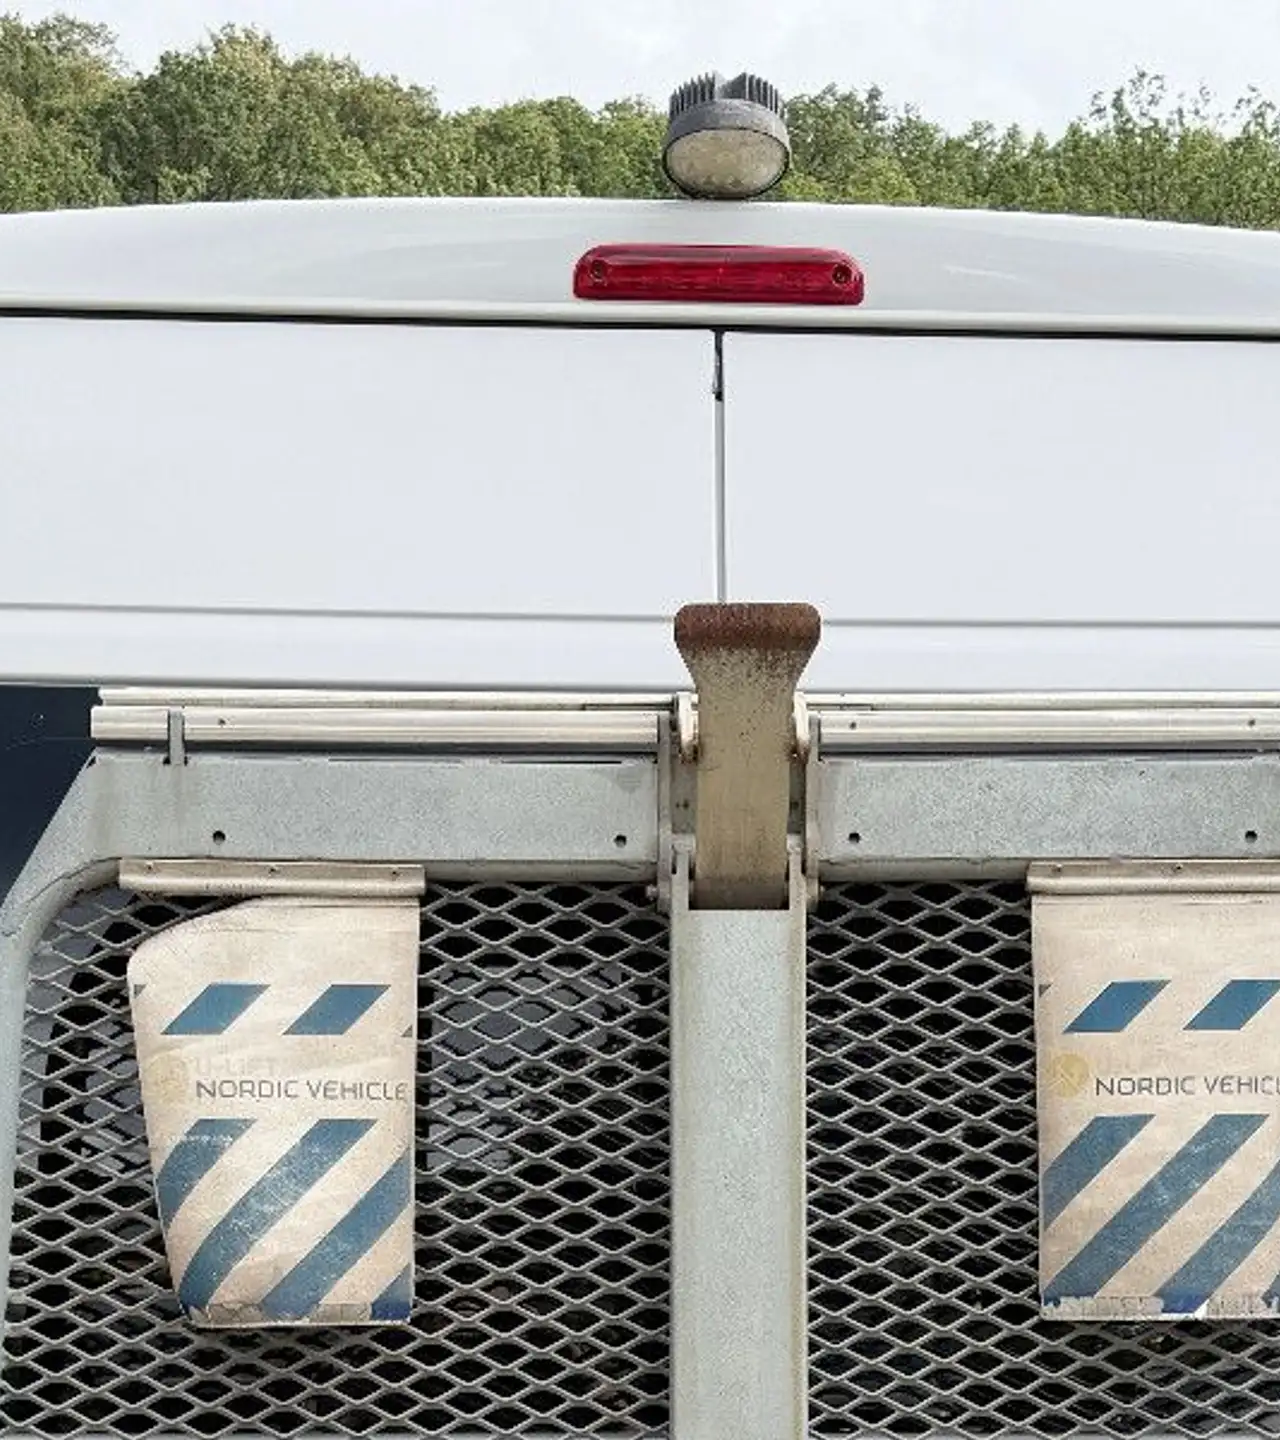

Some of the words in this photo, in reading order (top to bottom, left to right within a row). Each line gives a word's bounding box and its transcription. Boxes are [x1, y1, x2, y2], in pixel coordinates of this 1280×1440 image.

[195, 1079, 299, 1099] NORDIC
[305, 1080, 409, 1100] VEHICLE
[1095, 1075, 1196, 1096] NORDIC
